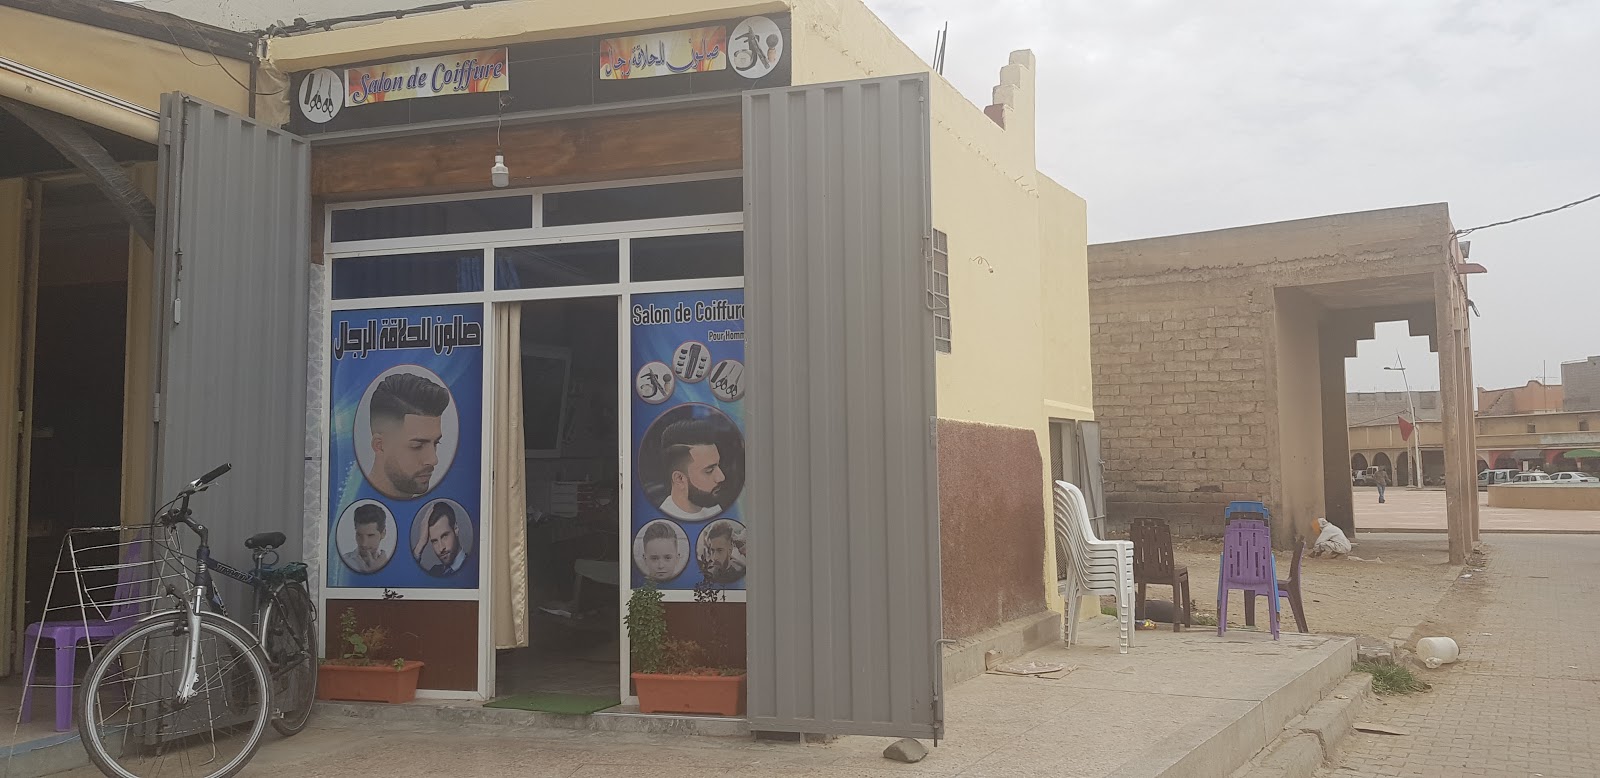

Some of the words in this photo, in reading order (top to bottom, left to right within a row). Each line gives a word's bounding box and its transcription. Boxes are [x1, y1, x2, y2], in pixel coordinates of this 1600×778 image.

[631, 40, 666, 71] للحلاقة
[666, 37, 720, 73] صالون
[352, 71, 404, 103] Salon
[407, 66, 427, 89] de
[431, 58, 503, 93] Coiffure
[633, 303, 671, 326] Salon
[674, 301, 692, 324] de
[334, 318, 378, 360] الرجال
[379, 316, 433, 350] للحلاقة
[433, 314, 482, 355] صالون
[708, 330, 725, 342] Pour
